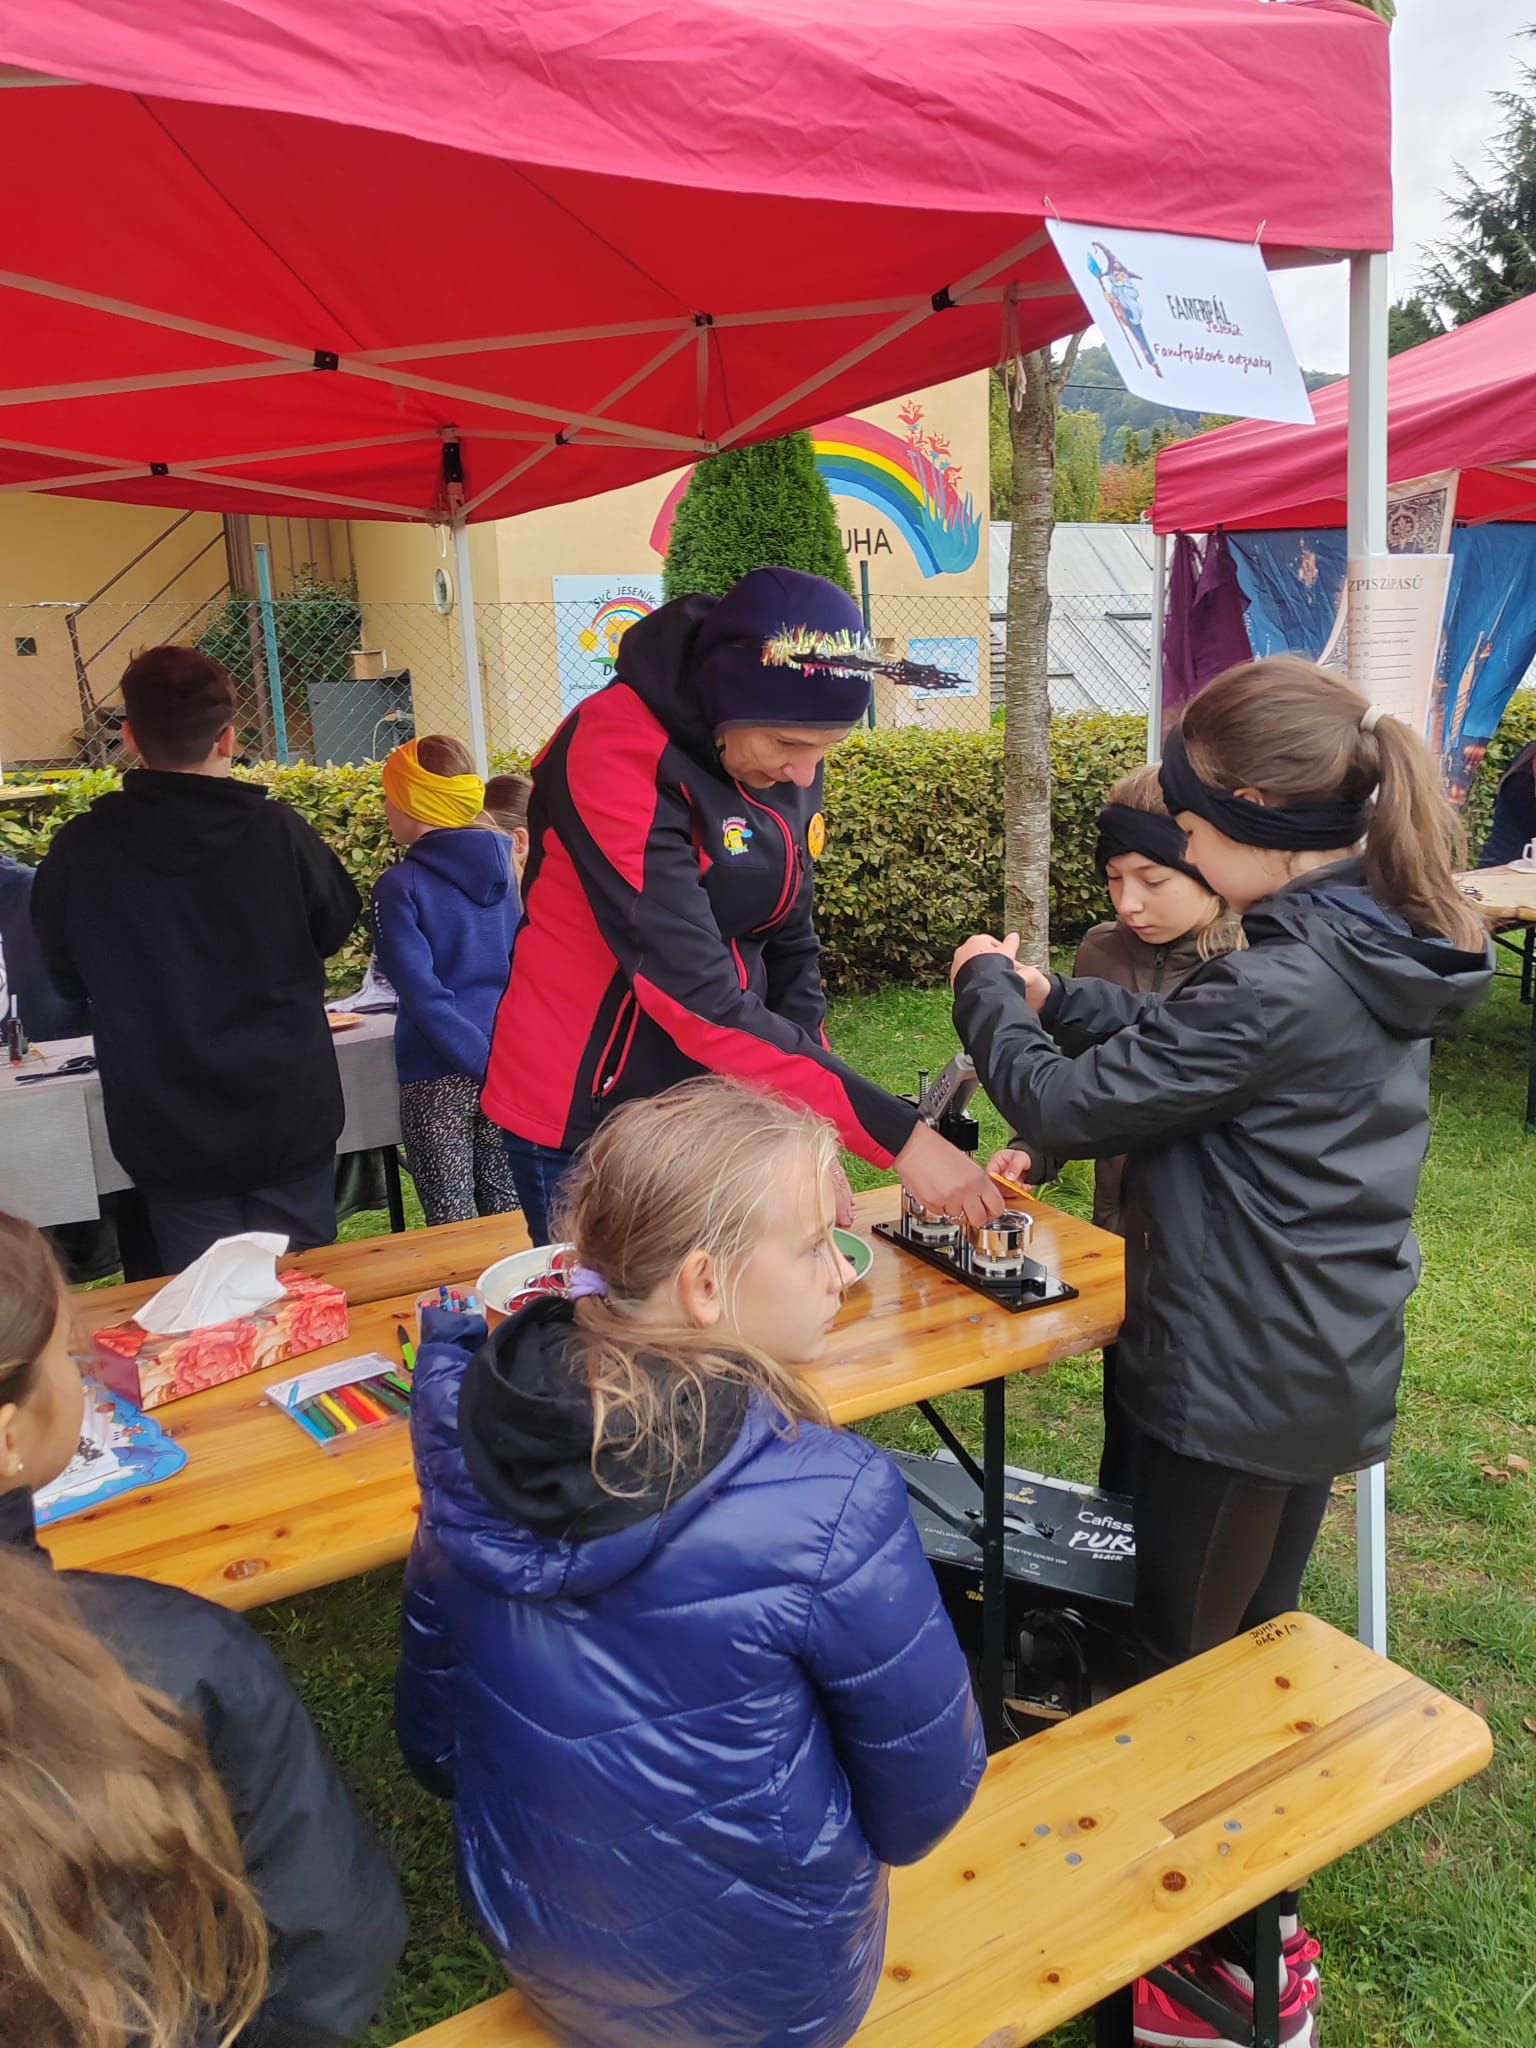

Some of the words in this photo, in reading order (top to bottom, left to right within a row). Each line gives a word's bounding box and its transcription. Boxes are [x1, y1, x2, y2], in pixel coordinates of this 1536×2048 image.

[839, 528, 893, 556] UHA
[617, 586, 656, 604] JESENÍK
[1348, 578, 1378, 593] ZPIS
[1078, 1511, 1134, 1534] Cafiss
[1068, 1530, 1135, 1553] PUR
